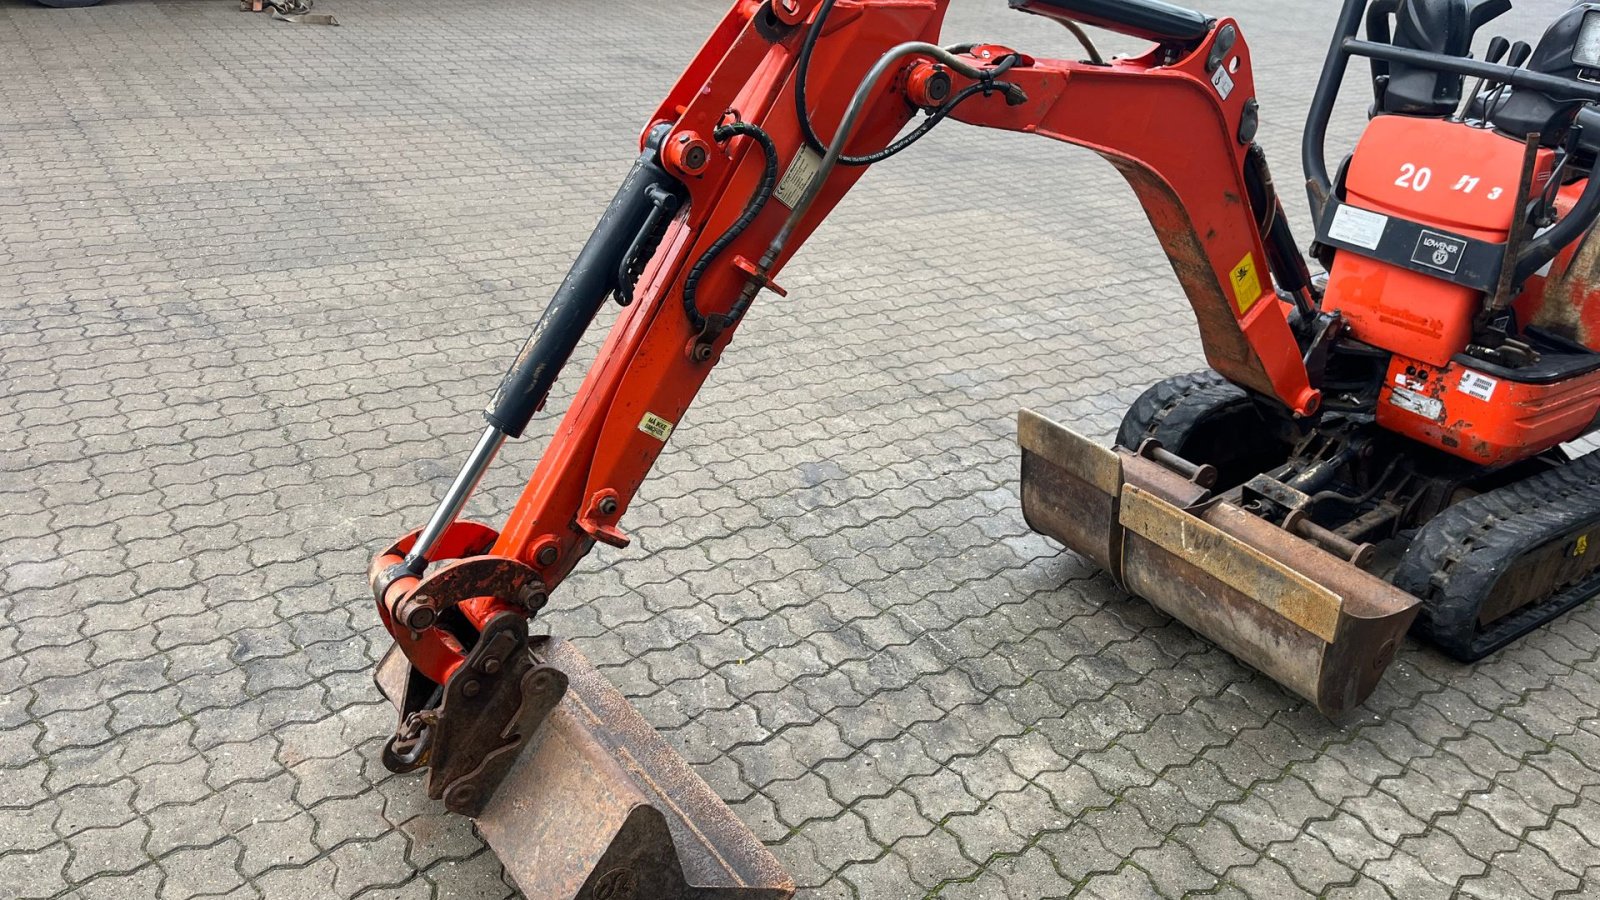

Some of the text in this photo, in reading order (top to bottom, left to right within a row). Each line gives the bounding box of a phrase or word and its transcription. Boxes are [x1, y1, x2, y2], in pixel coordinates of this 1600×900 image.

[1394, 163, 1432, 191] 20
[1487, 186, 1503, 200] 3
[1423, 237, 1458, 254] LØWENER
